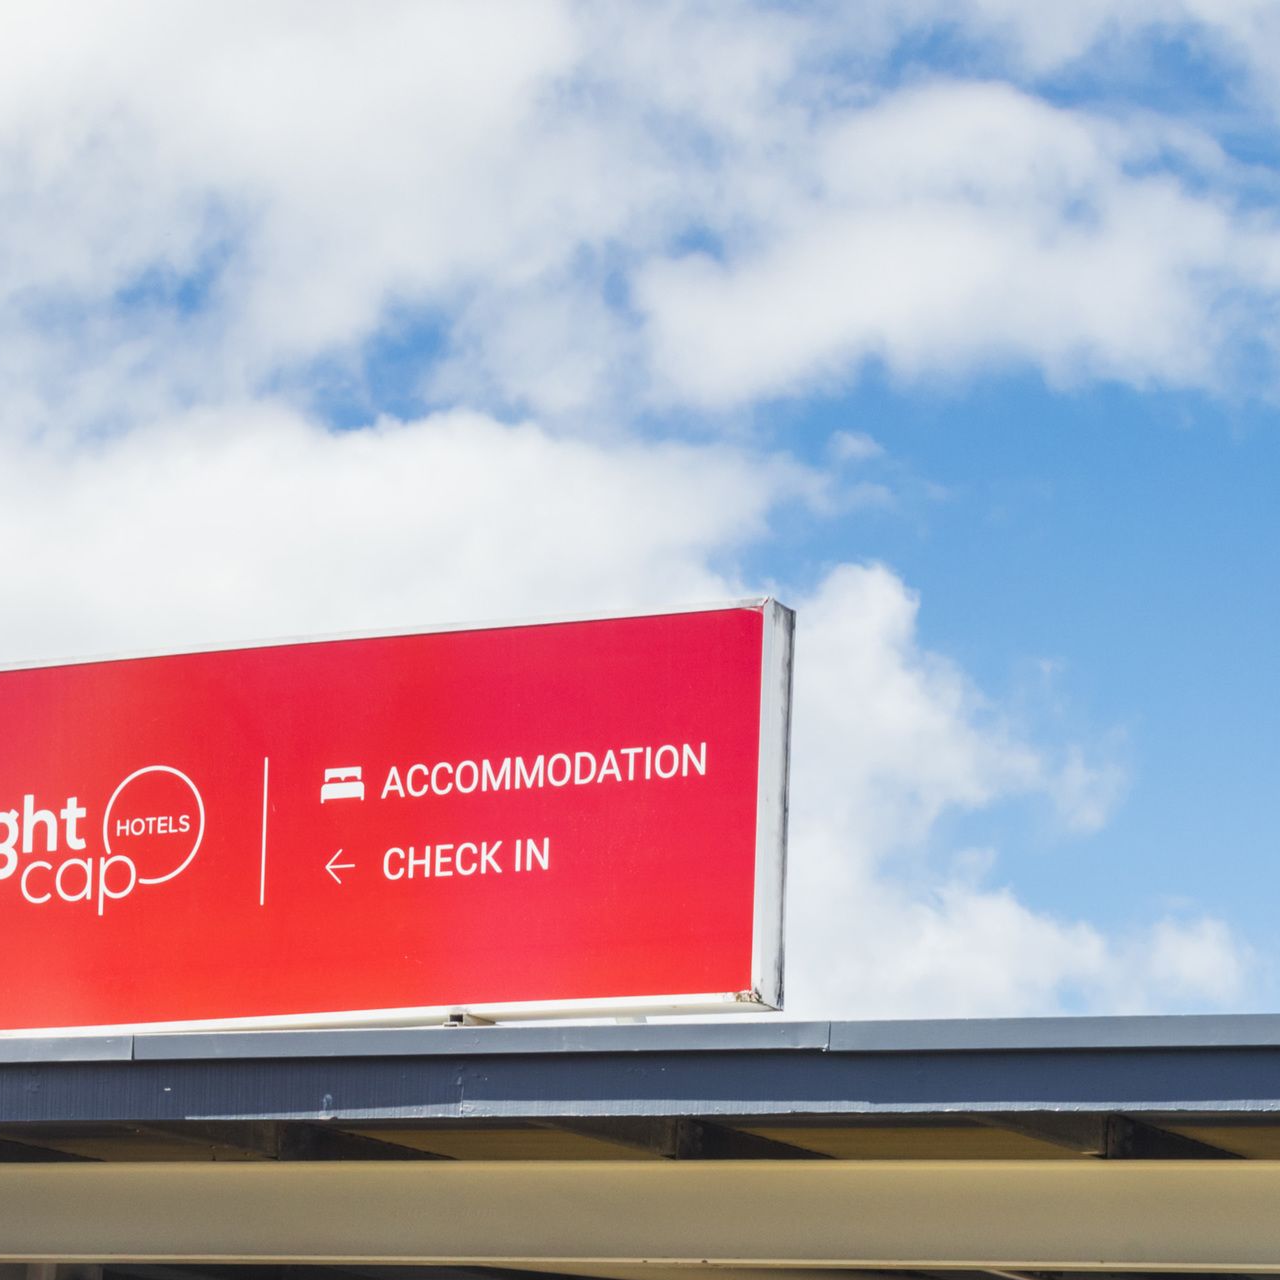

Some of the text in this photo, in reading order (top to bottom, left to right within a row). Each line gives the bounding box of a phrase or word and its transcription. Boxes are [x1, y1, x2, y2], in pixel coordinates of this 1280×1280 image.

[381, 742, 707, 799] ACCOMMODATION
[117, 815, 190, 837] HOTELS
[384, 838, 550, 881] CHECK IN
[21, 855, 137, 916] cap
